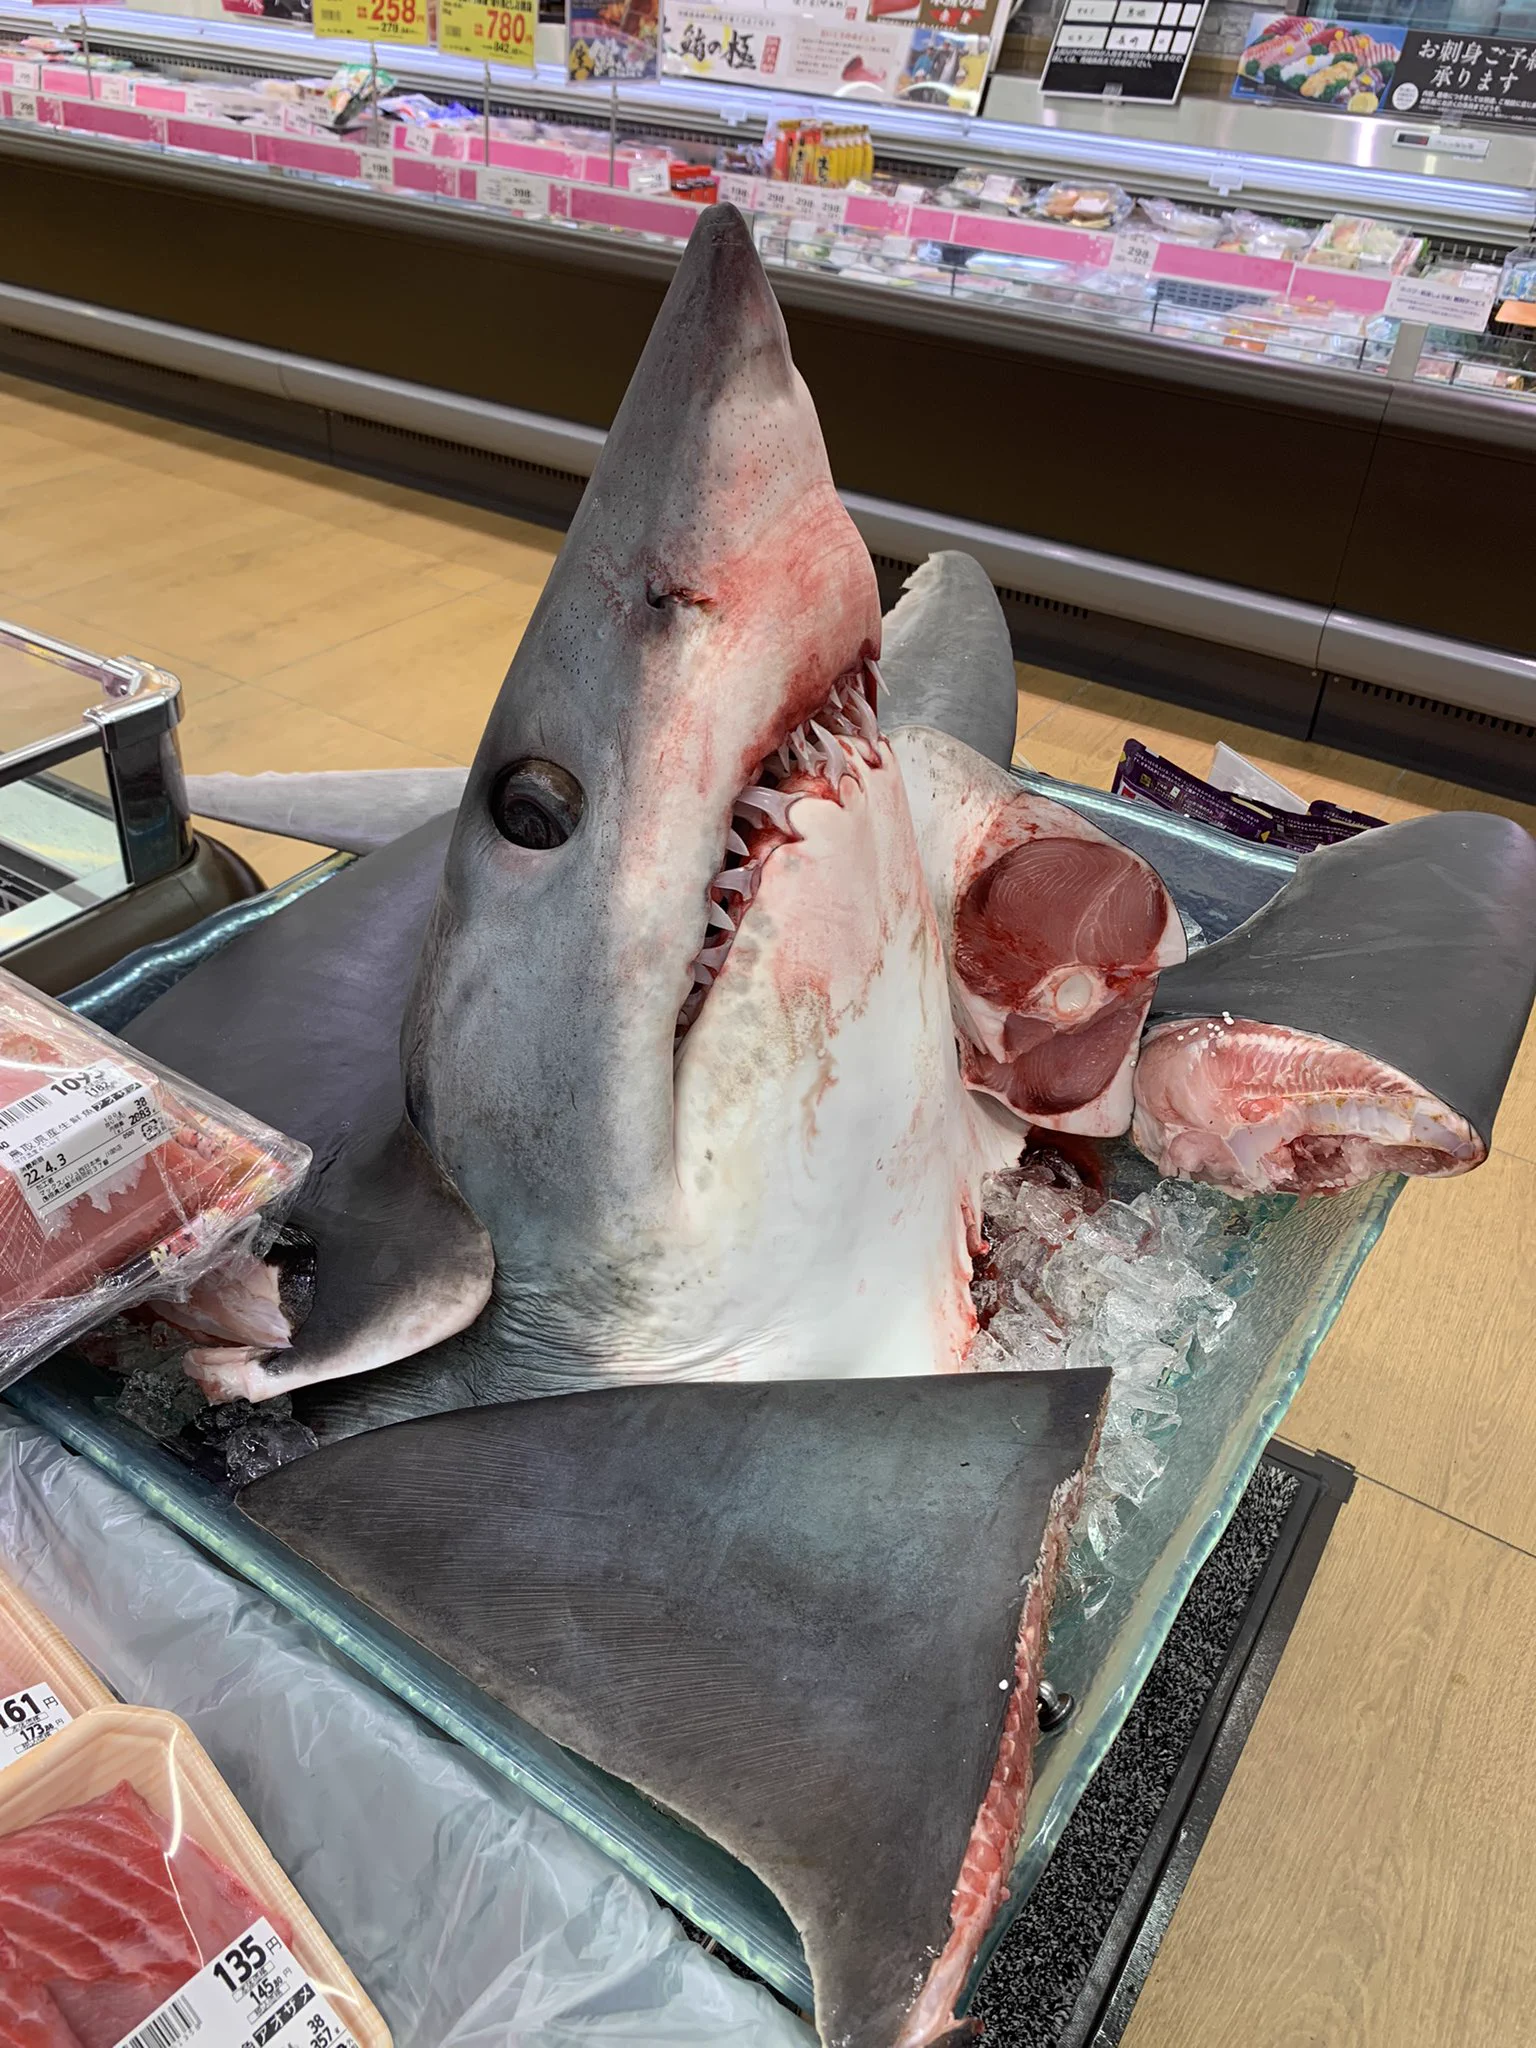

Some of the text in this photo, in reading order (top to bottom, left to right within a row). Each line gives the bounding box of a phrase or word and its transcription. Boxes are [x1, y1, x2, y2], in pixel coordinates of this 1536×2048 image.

[371, 0, 415, 24] 258
[487, 9, 525, 44] 780
[1430, 65, 1519, 95] 承ります
[134, 1096, 148, 1111] 38
[128, 1107, 152, 1127] 2883
[43, 1696, 59, 1709] 円
[55, 1718, 65, 1726] 円
[213, 1934, 283, 1992] 135 円
[283, 1967, 293, 1978] 円
[254, 1984, 315, 2046] アオザメ
[307, 2013, 325, 2035] 38
